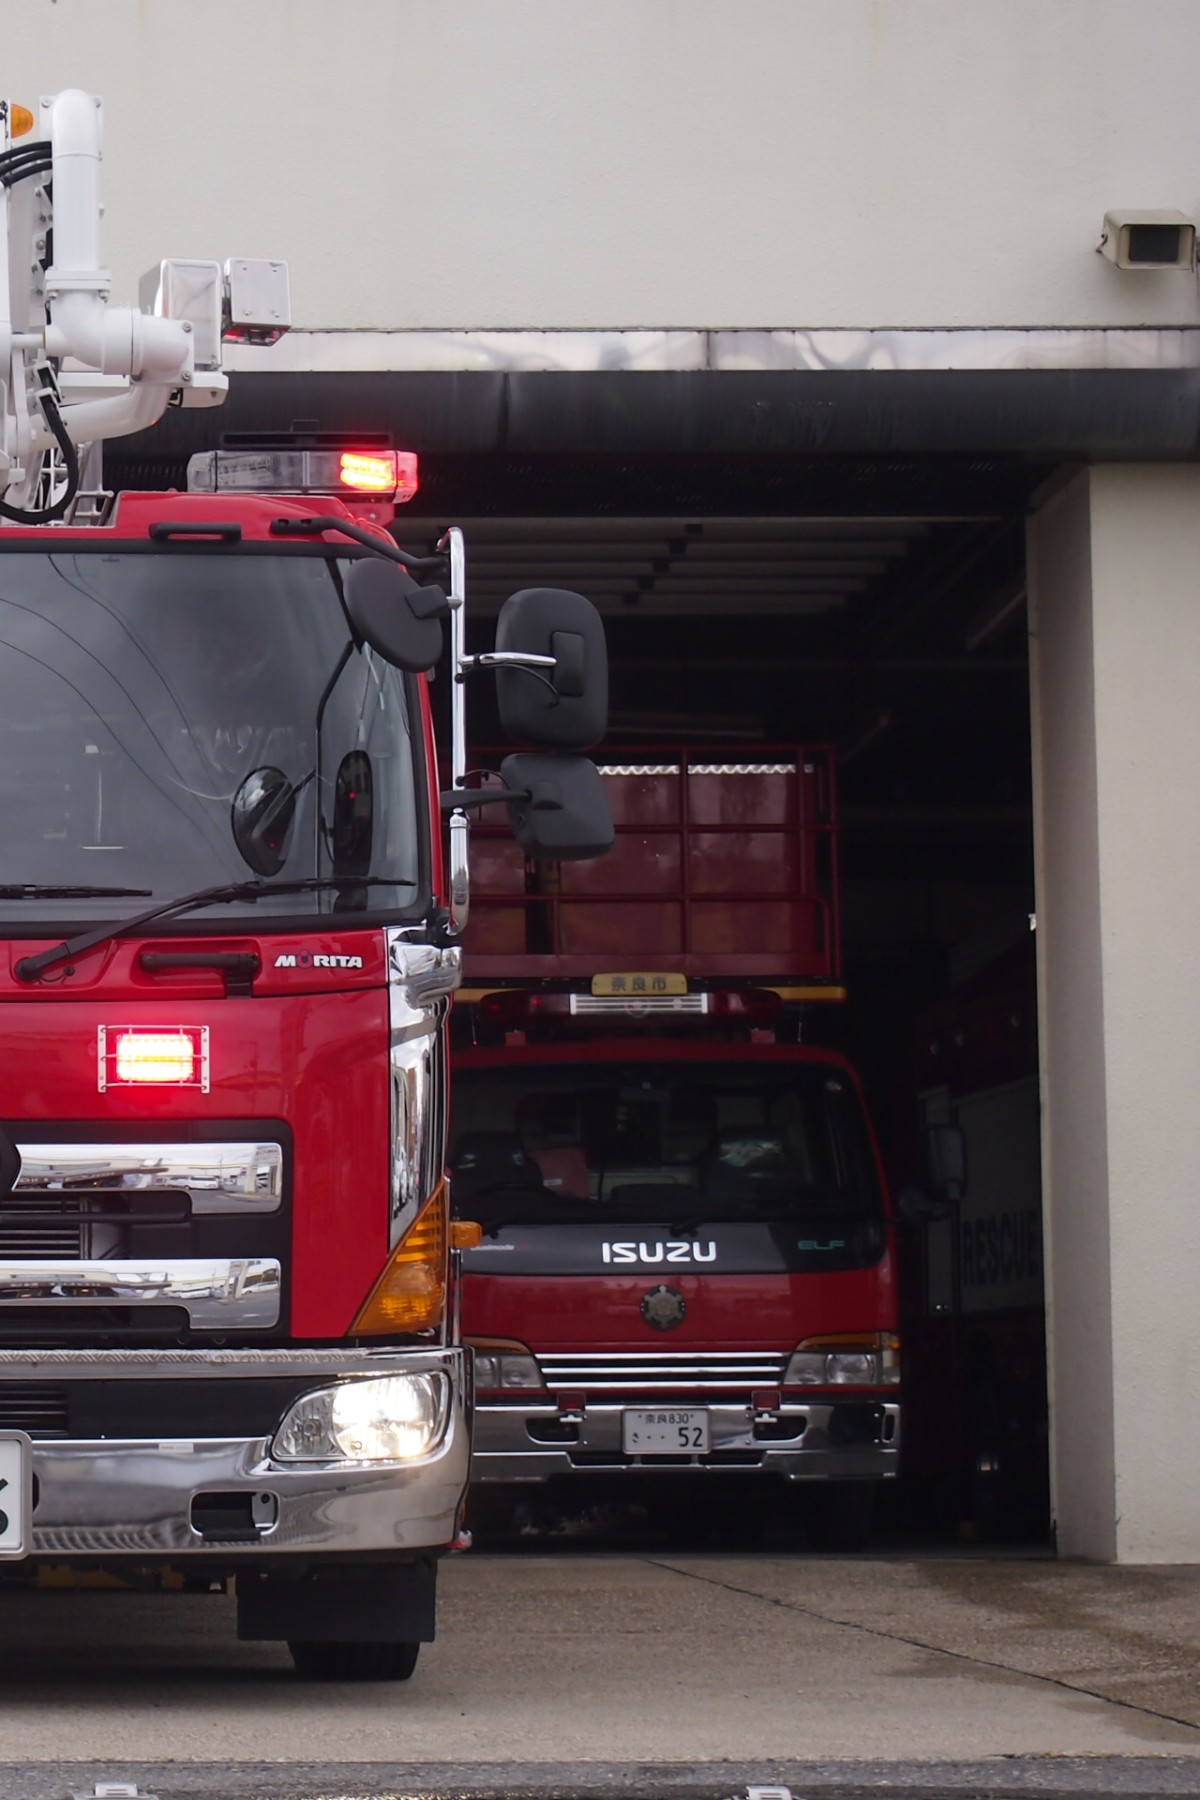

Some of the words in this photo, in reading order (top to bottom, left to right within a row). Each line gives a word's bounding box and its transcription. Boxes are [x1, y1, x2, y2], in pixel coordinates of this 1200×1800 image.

[274, 950, 362, 968] MORITA
[610, 976, 667, 992] 奈良市
[602, 1241, 716, 1263] ISUZU
